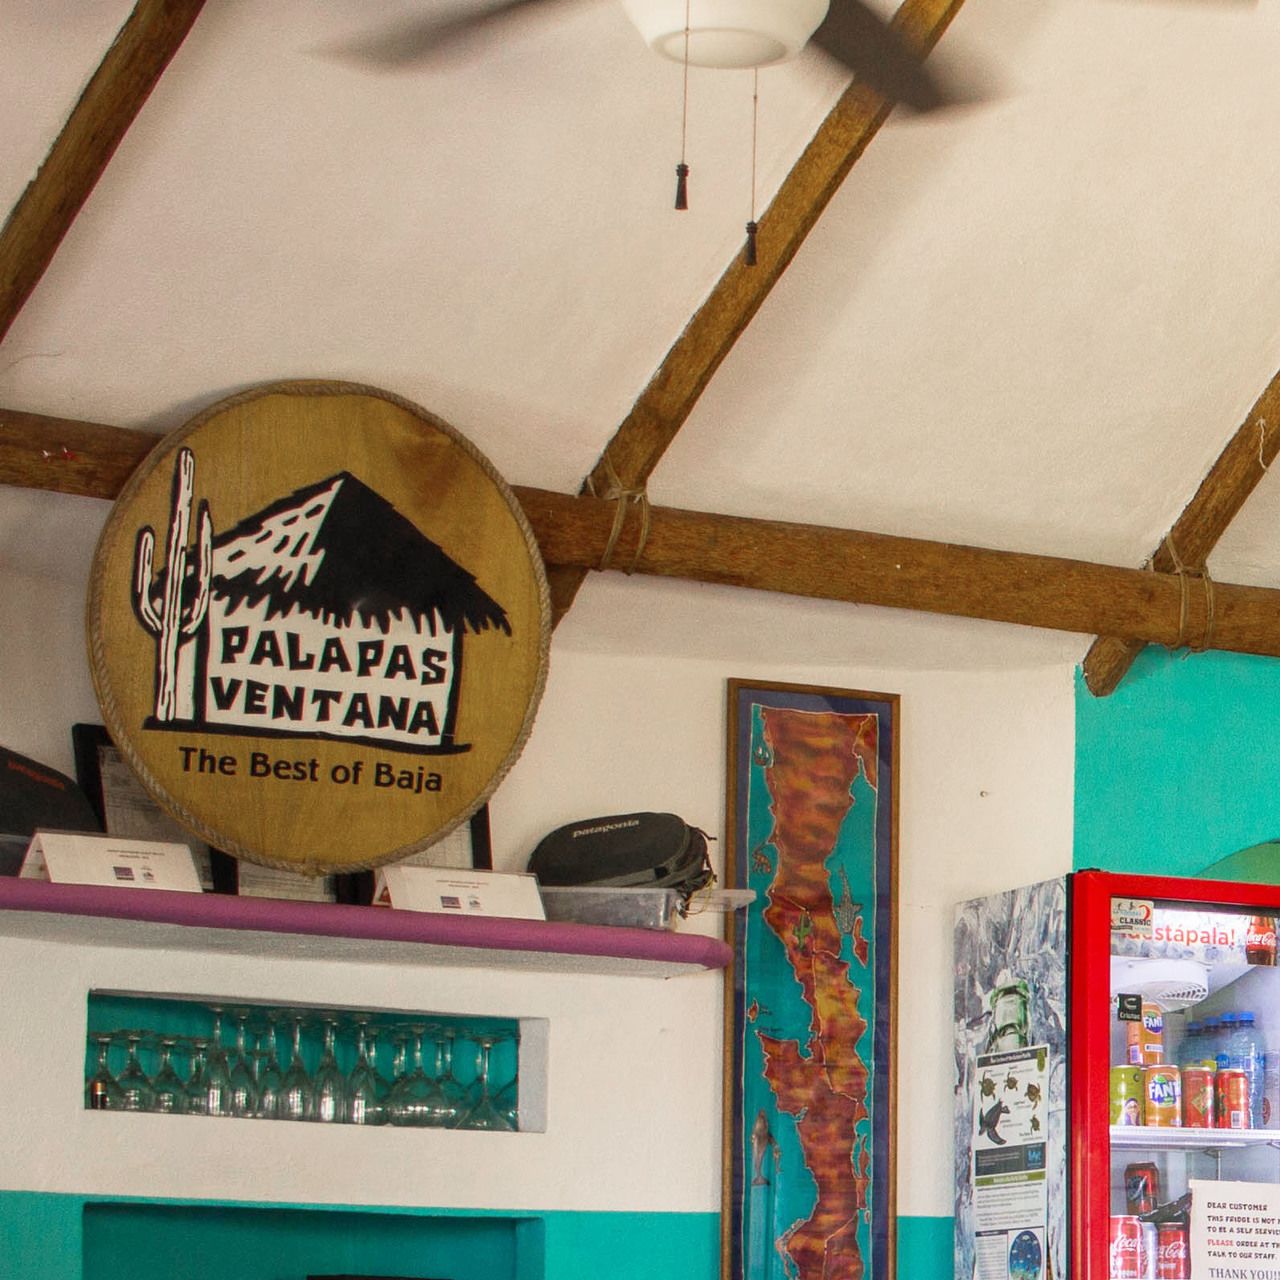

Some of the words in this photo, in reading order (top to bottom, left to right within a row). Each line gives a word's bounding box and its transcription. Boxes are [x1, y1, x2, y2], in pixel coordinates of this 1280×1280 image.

[221, 626, 447, 685] PALAPAS
[210, 677, 440, 735] VENTANA
[178, 747, 237, 775] The
[251, 752, 319, 782] Best
[331, 761, 363, 784] of
[375, 763, 442, 793] Baja
[1229, 1203, 1268, 1211] CUSTOMER
[1207, 1239, 1234, 1247] PLEASE
[1208, 1268, 1248, 1280] THANK
[1250, 1270, 1280, 1280] YOU!!
